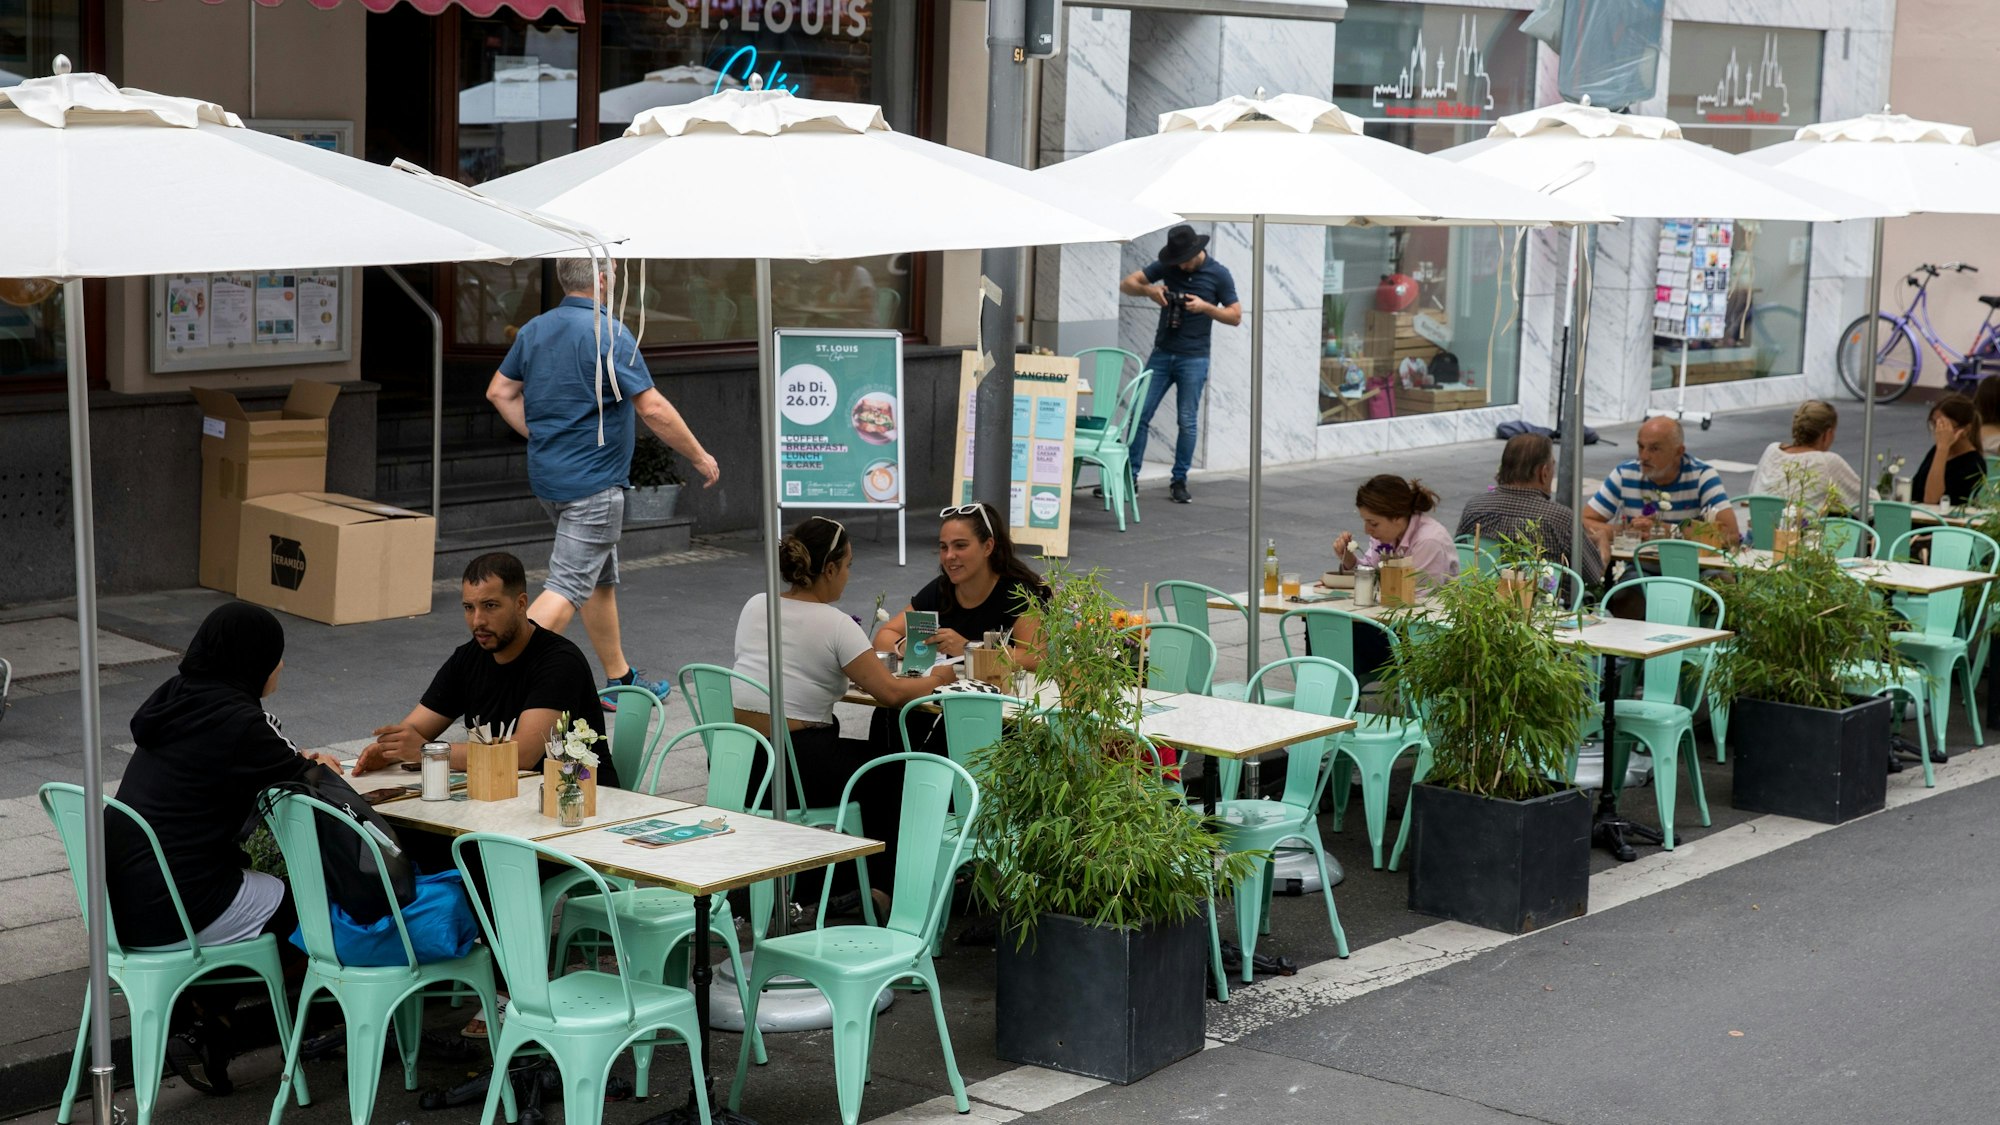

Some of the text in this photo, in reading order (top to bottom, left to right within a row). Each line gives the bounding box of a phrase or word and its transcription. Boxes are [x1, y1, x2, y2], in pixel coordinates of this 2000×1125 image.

[666, 0, 867, 37] ST. LOUIS
[816, 344, 858, 353] ST. LOUIS
[1013, 370, 1070, 381] SANGEBOT
[788, 381, 827, 393] ab Di.
[786, 395, 830, 407] 26.07.
[786, 434, 827, 443] COFFEE,
[786, 443, 846, 452] BREAKFAST,
[786, 452, 820, 460] LUNCH
